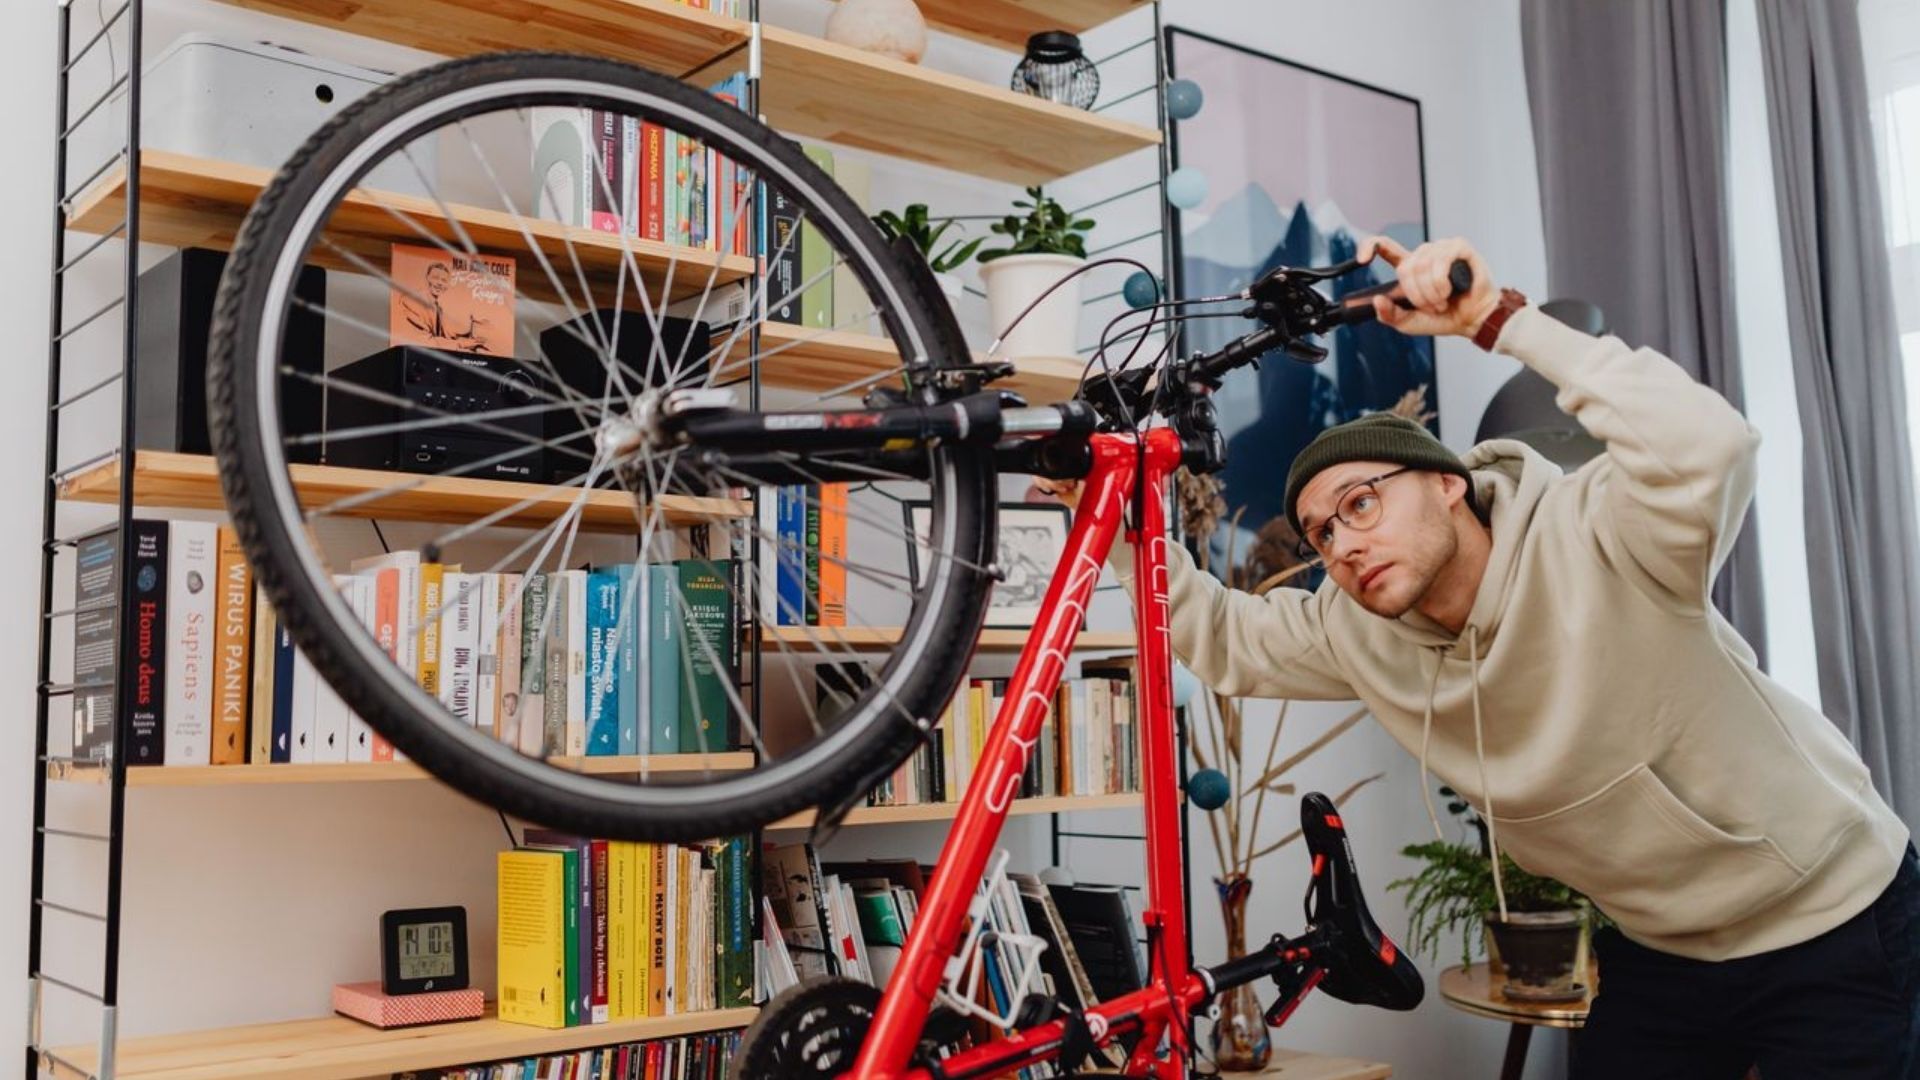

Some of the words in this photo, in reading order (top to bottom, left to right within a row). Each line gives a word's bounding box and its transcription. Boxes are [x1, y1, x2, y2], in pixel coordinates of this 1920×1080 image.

[649, 128, 659, 180] HISZPANIA
[491, 262, 510, 276] COLE
[462, 358, 488, 367] SHARP
[226, 562, 246, 636] WIRUS
[139, 601, 156, 659] Homo
[591, 627, 603, 674] miasto
[180, 612, 204, 701] Sapiens
[138, 662, 156, 705] deus
[223, 643, 243, 722] PANIKI
[590, 675, 604, 720] świata
[596, 914, 606, 933] Takie
[655, 893, 664, 933] MŁYNY
[594, 934, 606, 951] buty
[596, 958, 606, 997] cholewami
